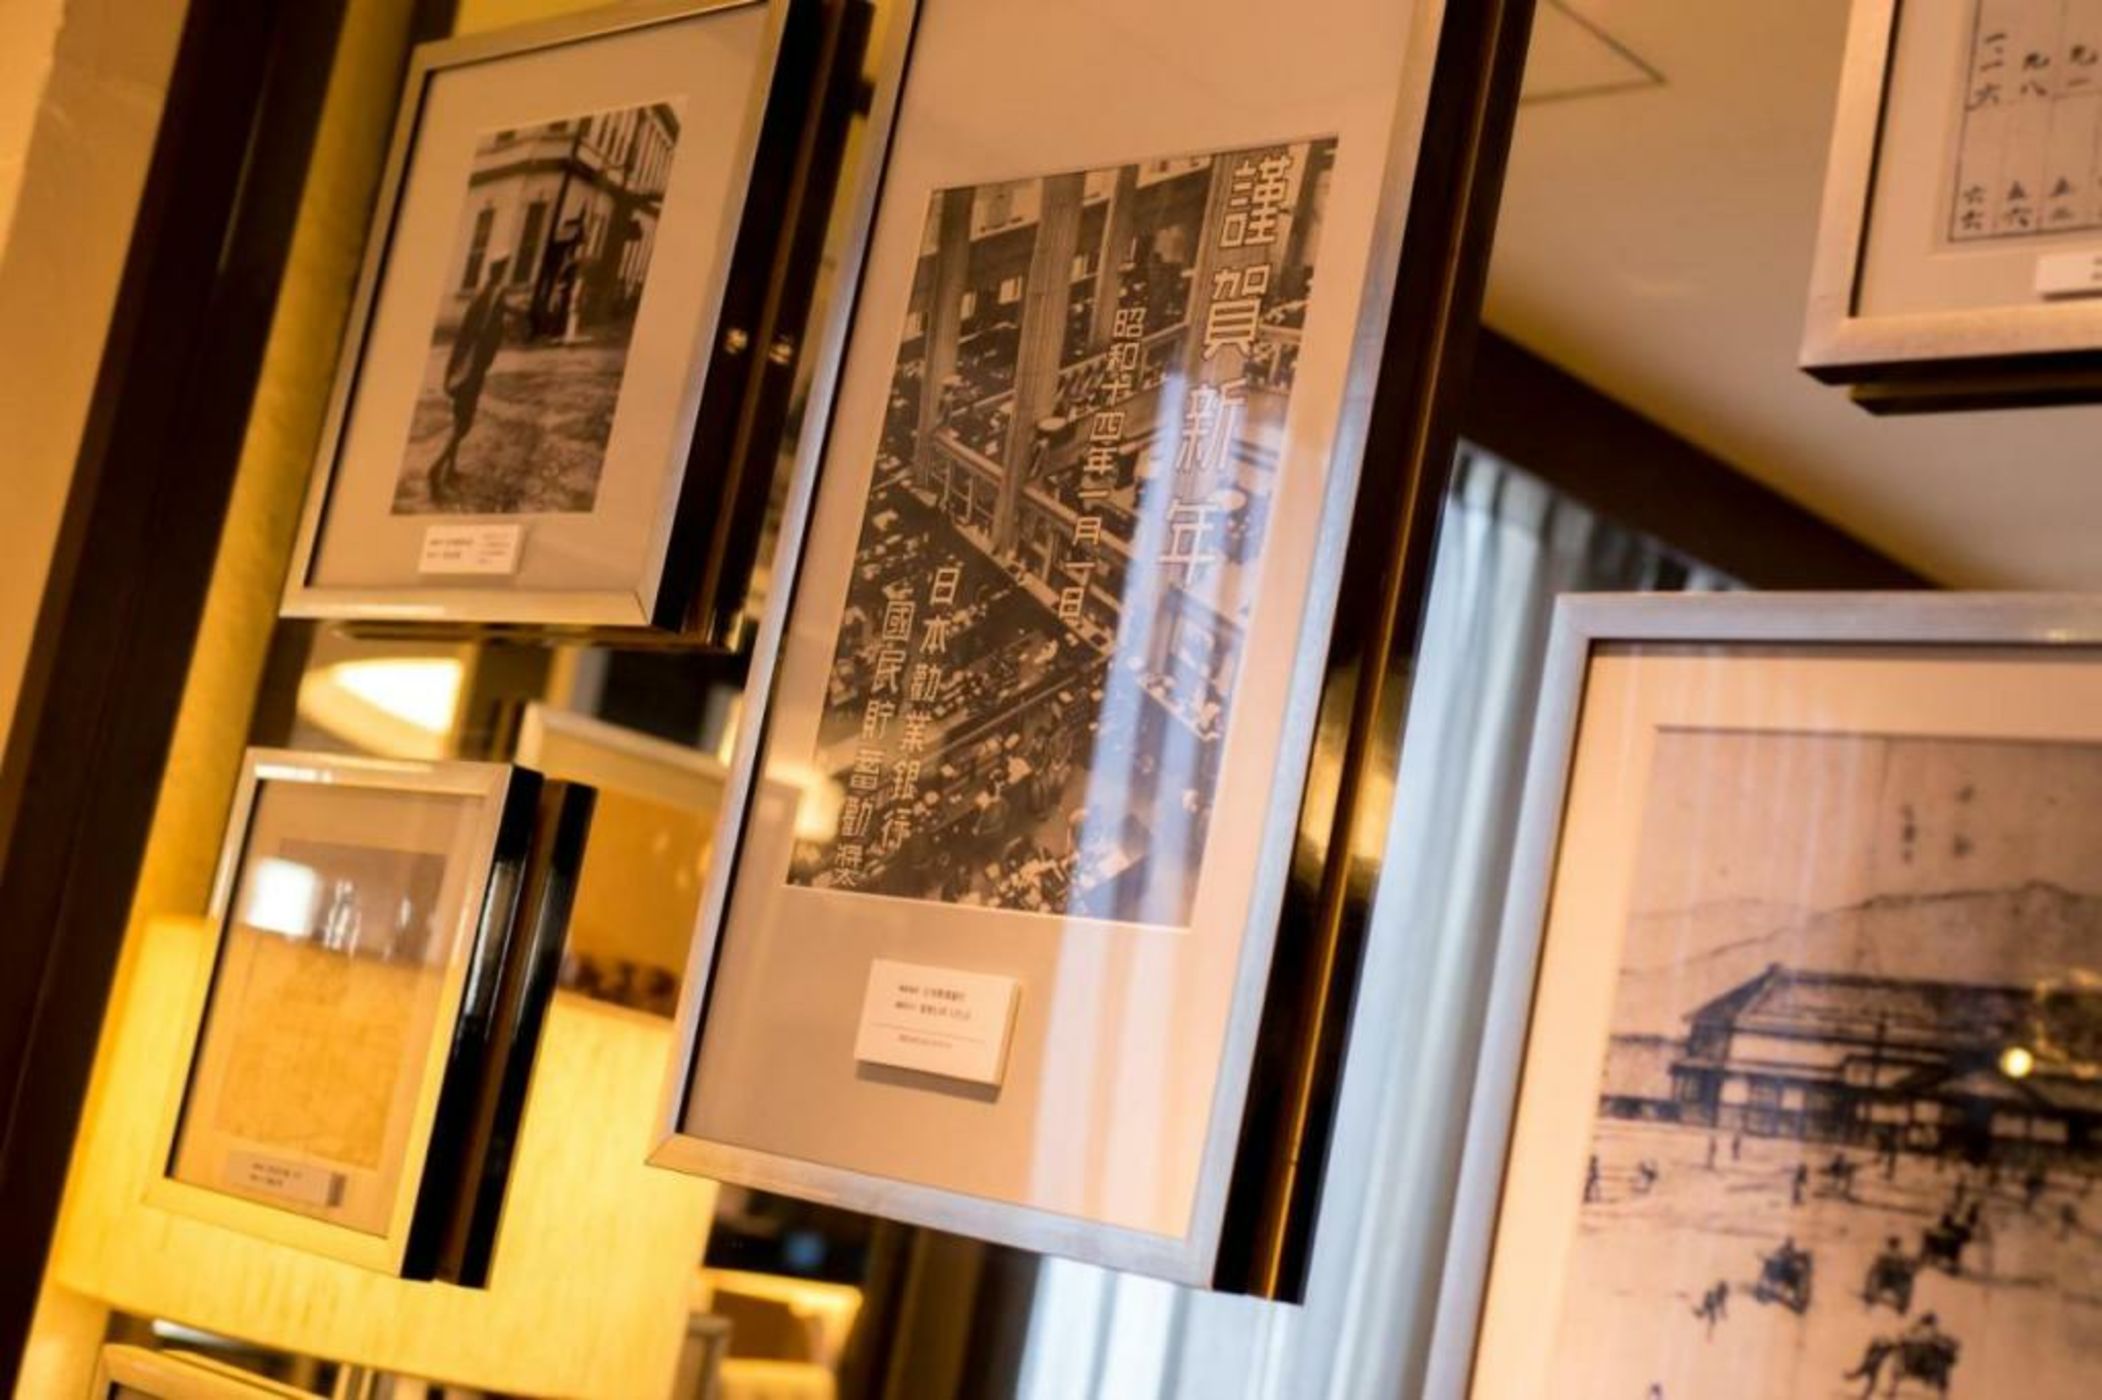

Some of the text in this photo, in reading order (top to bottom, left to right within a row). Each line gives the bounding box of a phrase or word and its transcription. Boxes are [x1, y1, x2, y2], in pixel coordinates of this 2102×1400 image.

[1058, 306, 1146, 618] 昭和十四年一月一日
[1158, 153, 1293, 586] 謹賀新年
